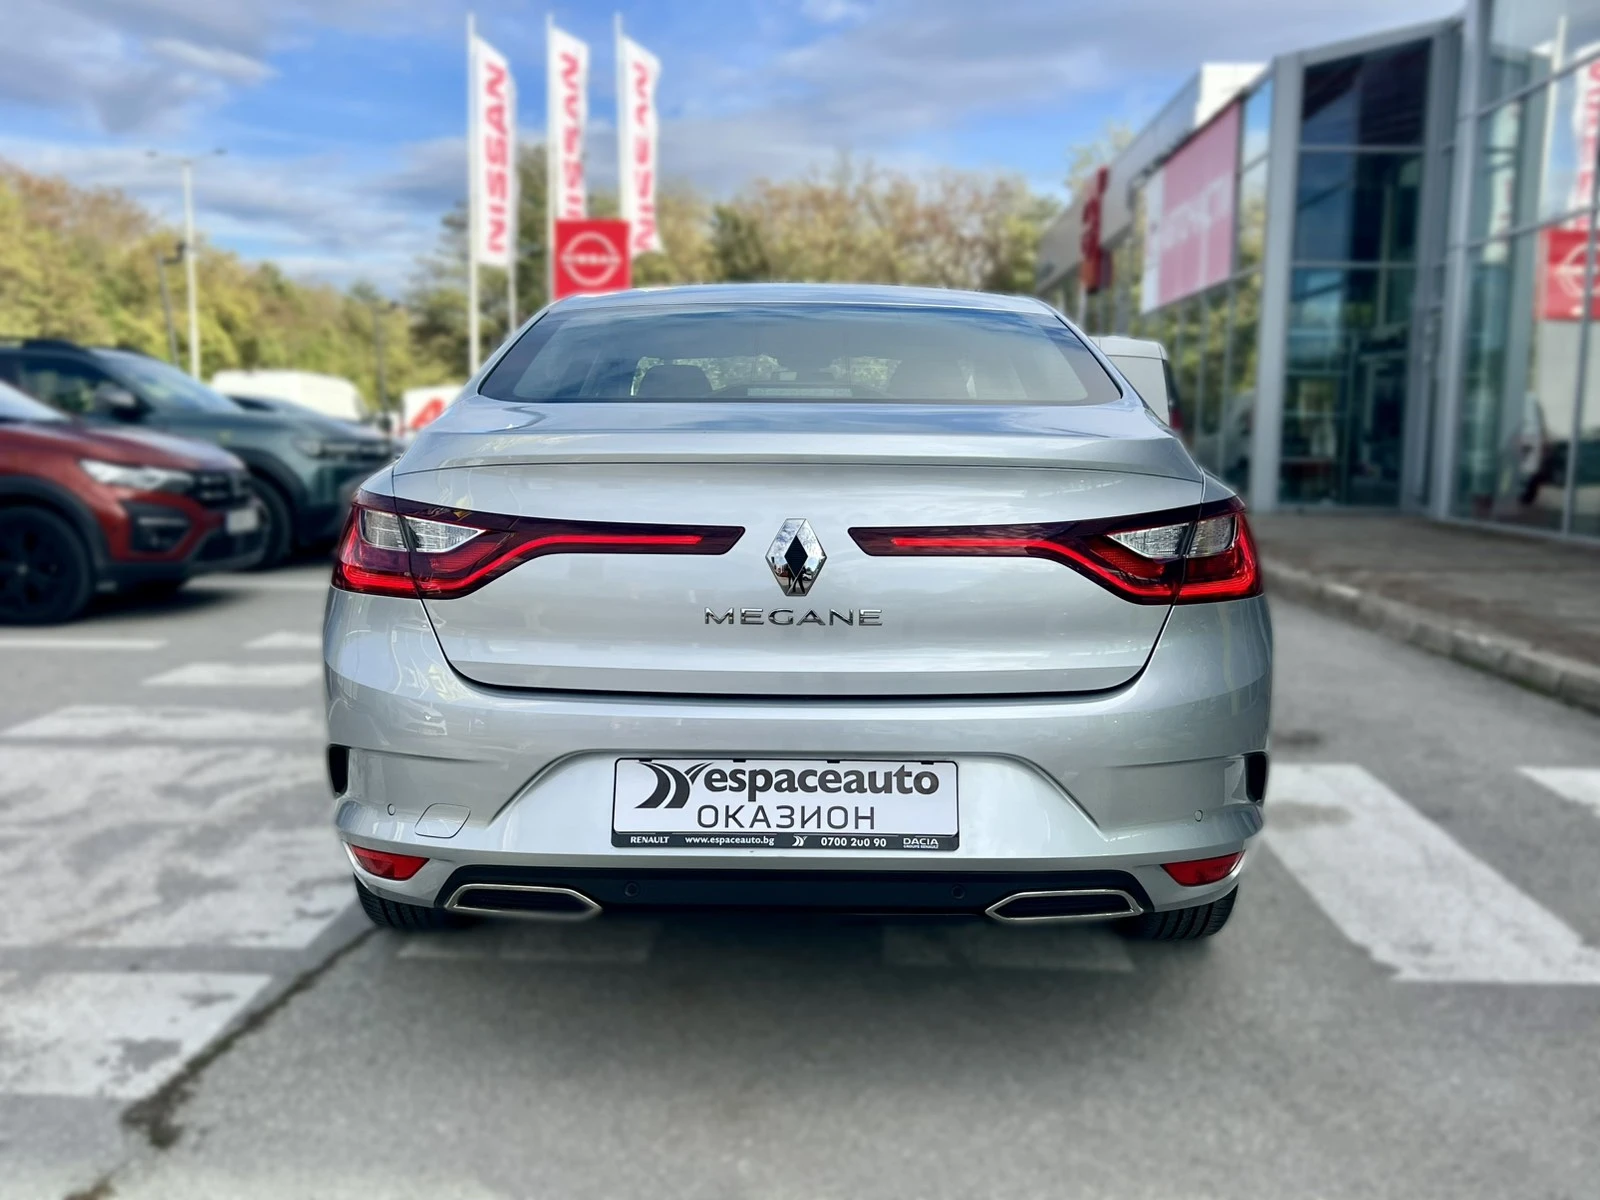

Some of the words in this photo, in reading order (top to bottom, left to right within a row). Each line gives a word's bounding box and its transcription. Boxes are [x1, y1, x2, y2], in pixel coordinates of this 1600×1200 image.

[484, 61, 508, 254] NISSAN
[633, 61, 657, 251] NISSAN
[704, 607, 883, 626] MEGANE
[704, 764, 940, 802] espaceauto
[697, 804, 875, 830] ОКАЗИОН
[630, 836, 670, 844] RENAULT
[684, 836, 775, 846] www.espaceauto.bg
[820, 837, 848, 847] 0700
[873, 838, 887, 848] 90
[903, 837, 939, 845] DACIA
